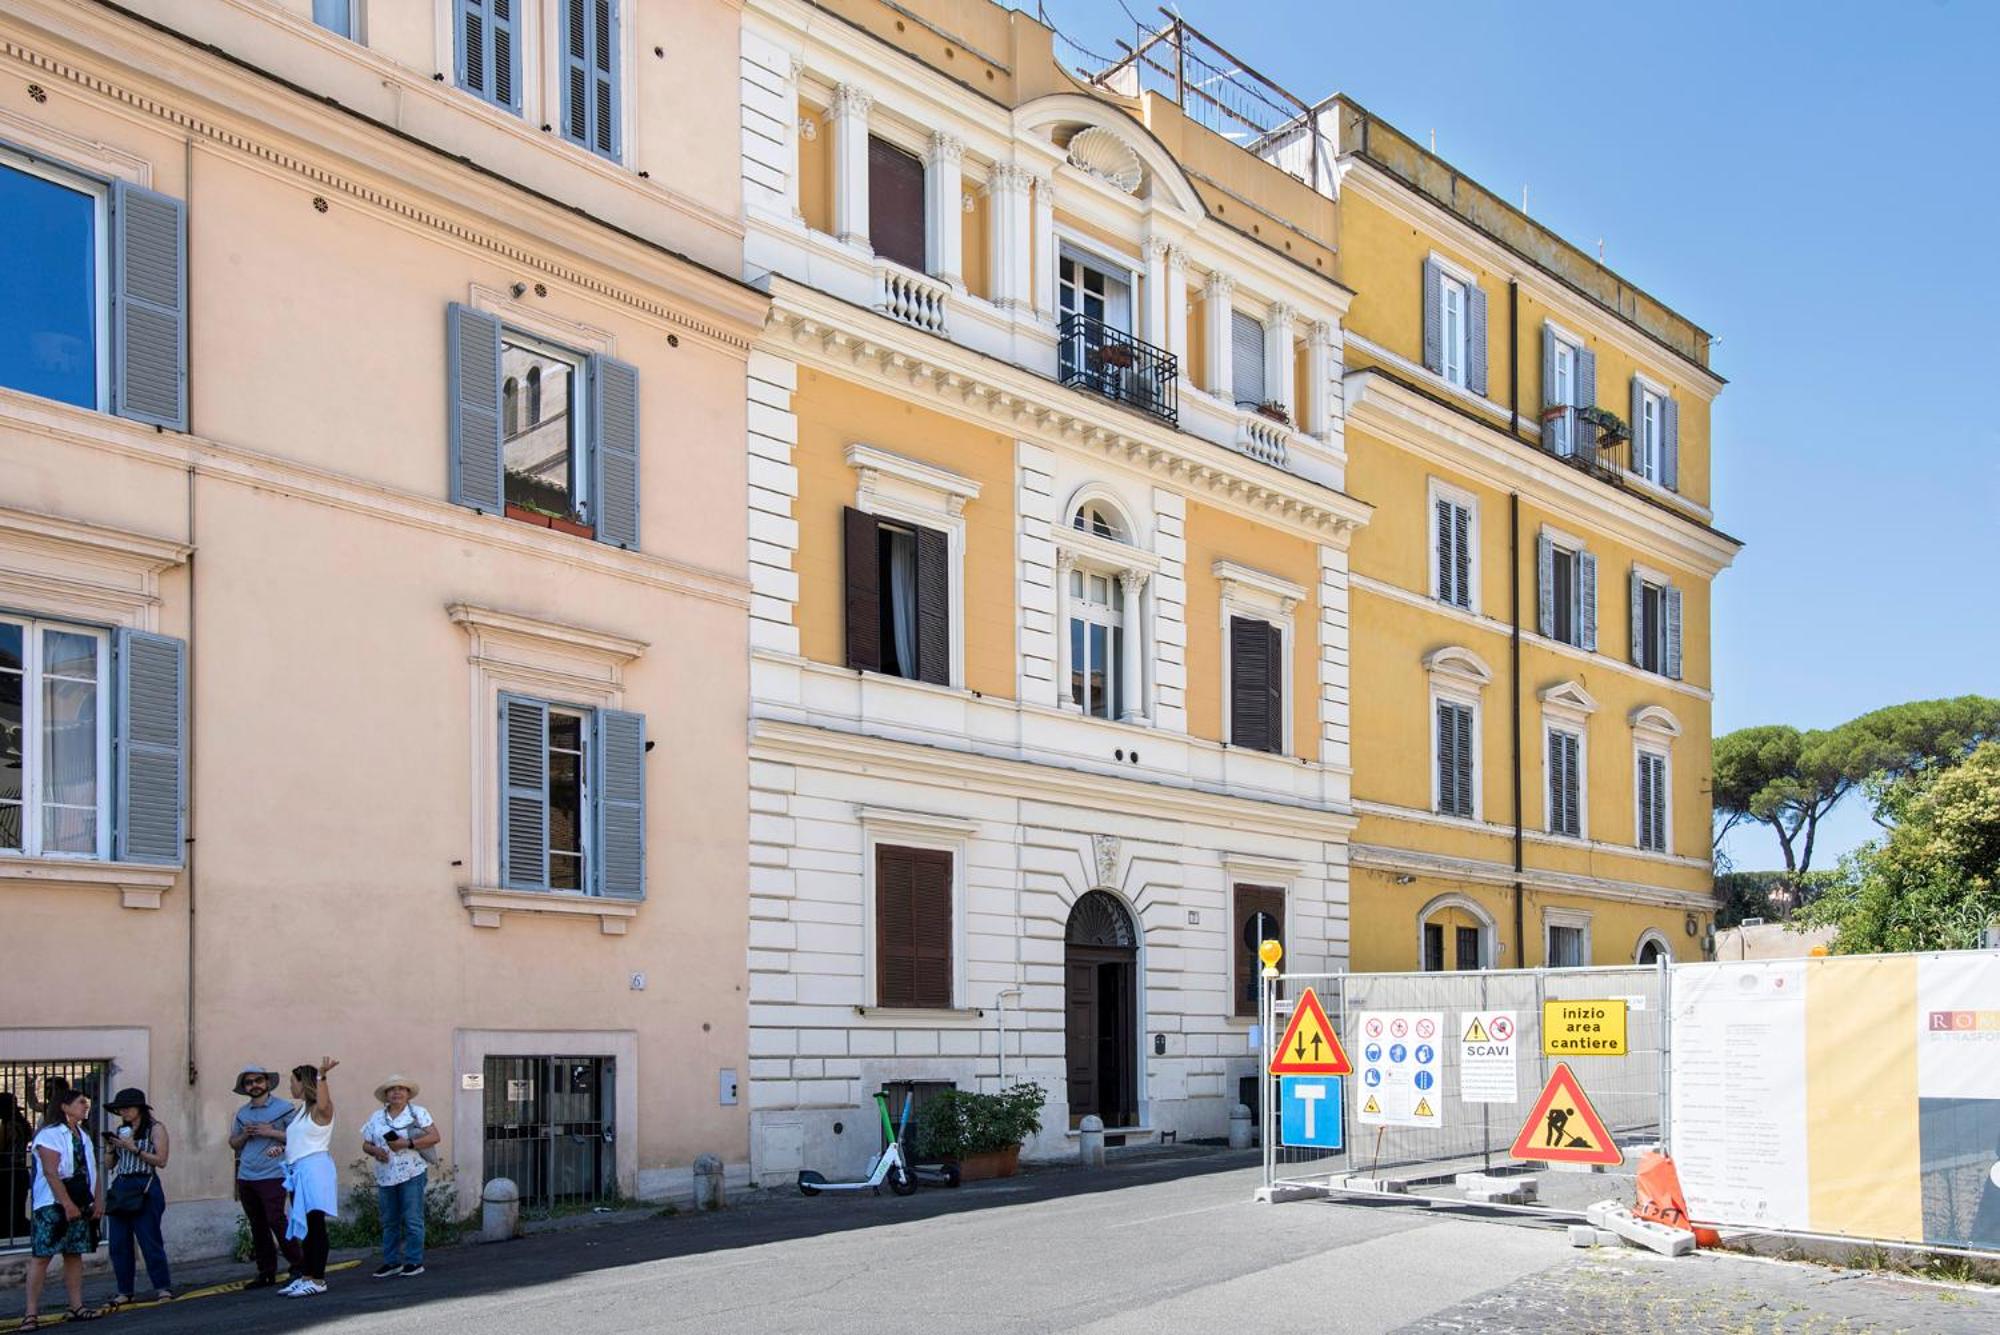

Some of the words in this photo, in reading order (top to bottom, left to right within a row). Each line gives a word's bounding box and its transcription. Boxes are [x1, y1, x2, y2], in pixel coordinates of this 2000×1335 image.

[1563, 1007, 1605, 1019] inizio
[1567, 1023, 1601, 1032] area
[1551, 1037, 1618, 1049] cantiere
[1467, 1045, 1509, 1056] SCAVI
